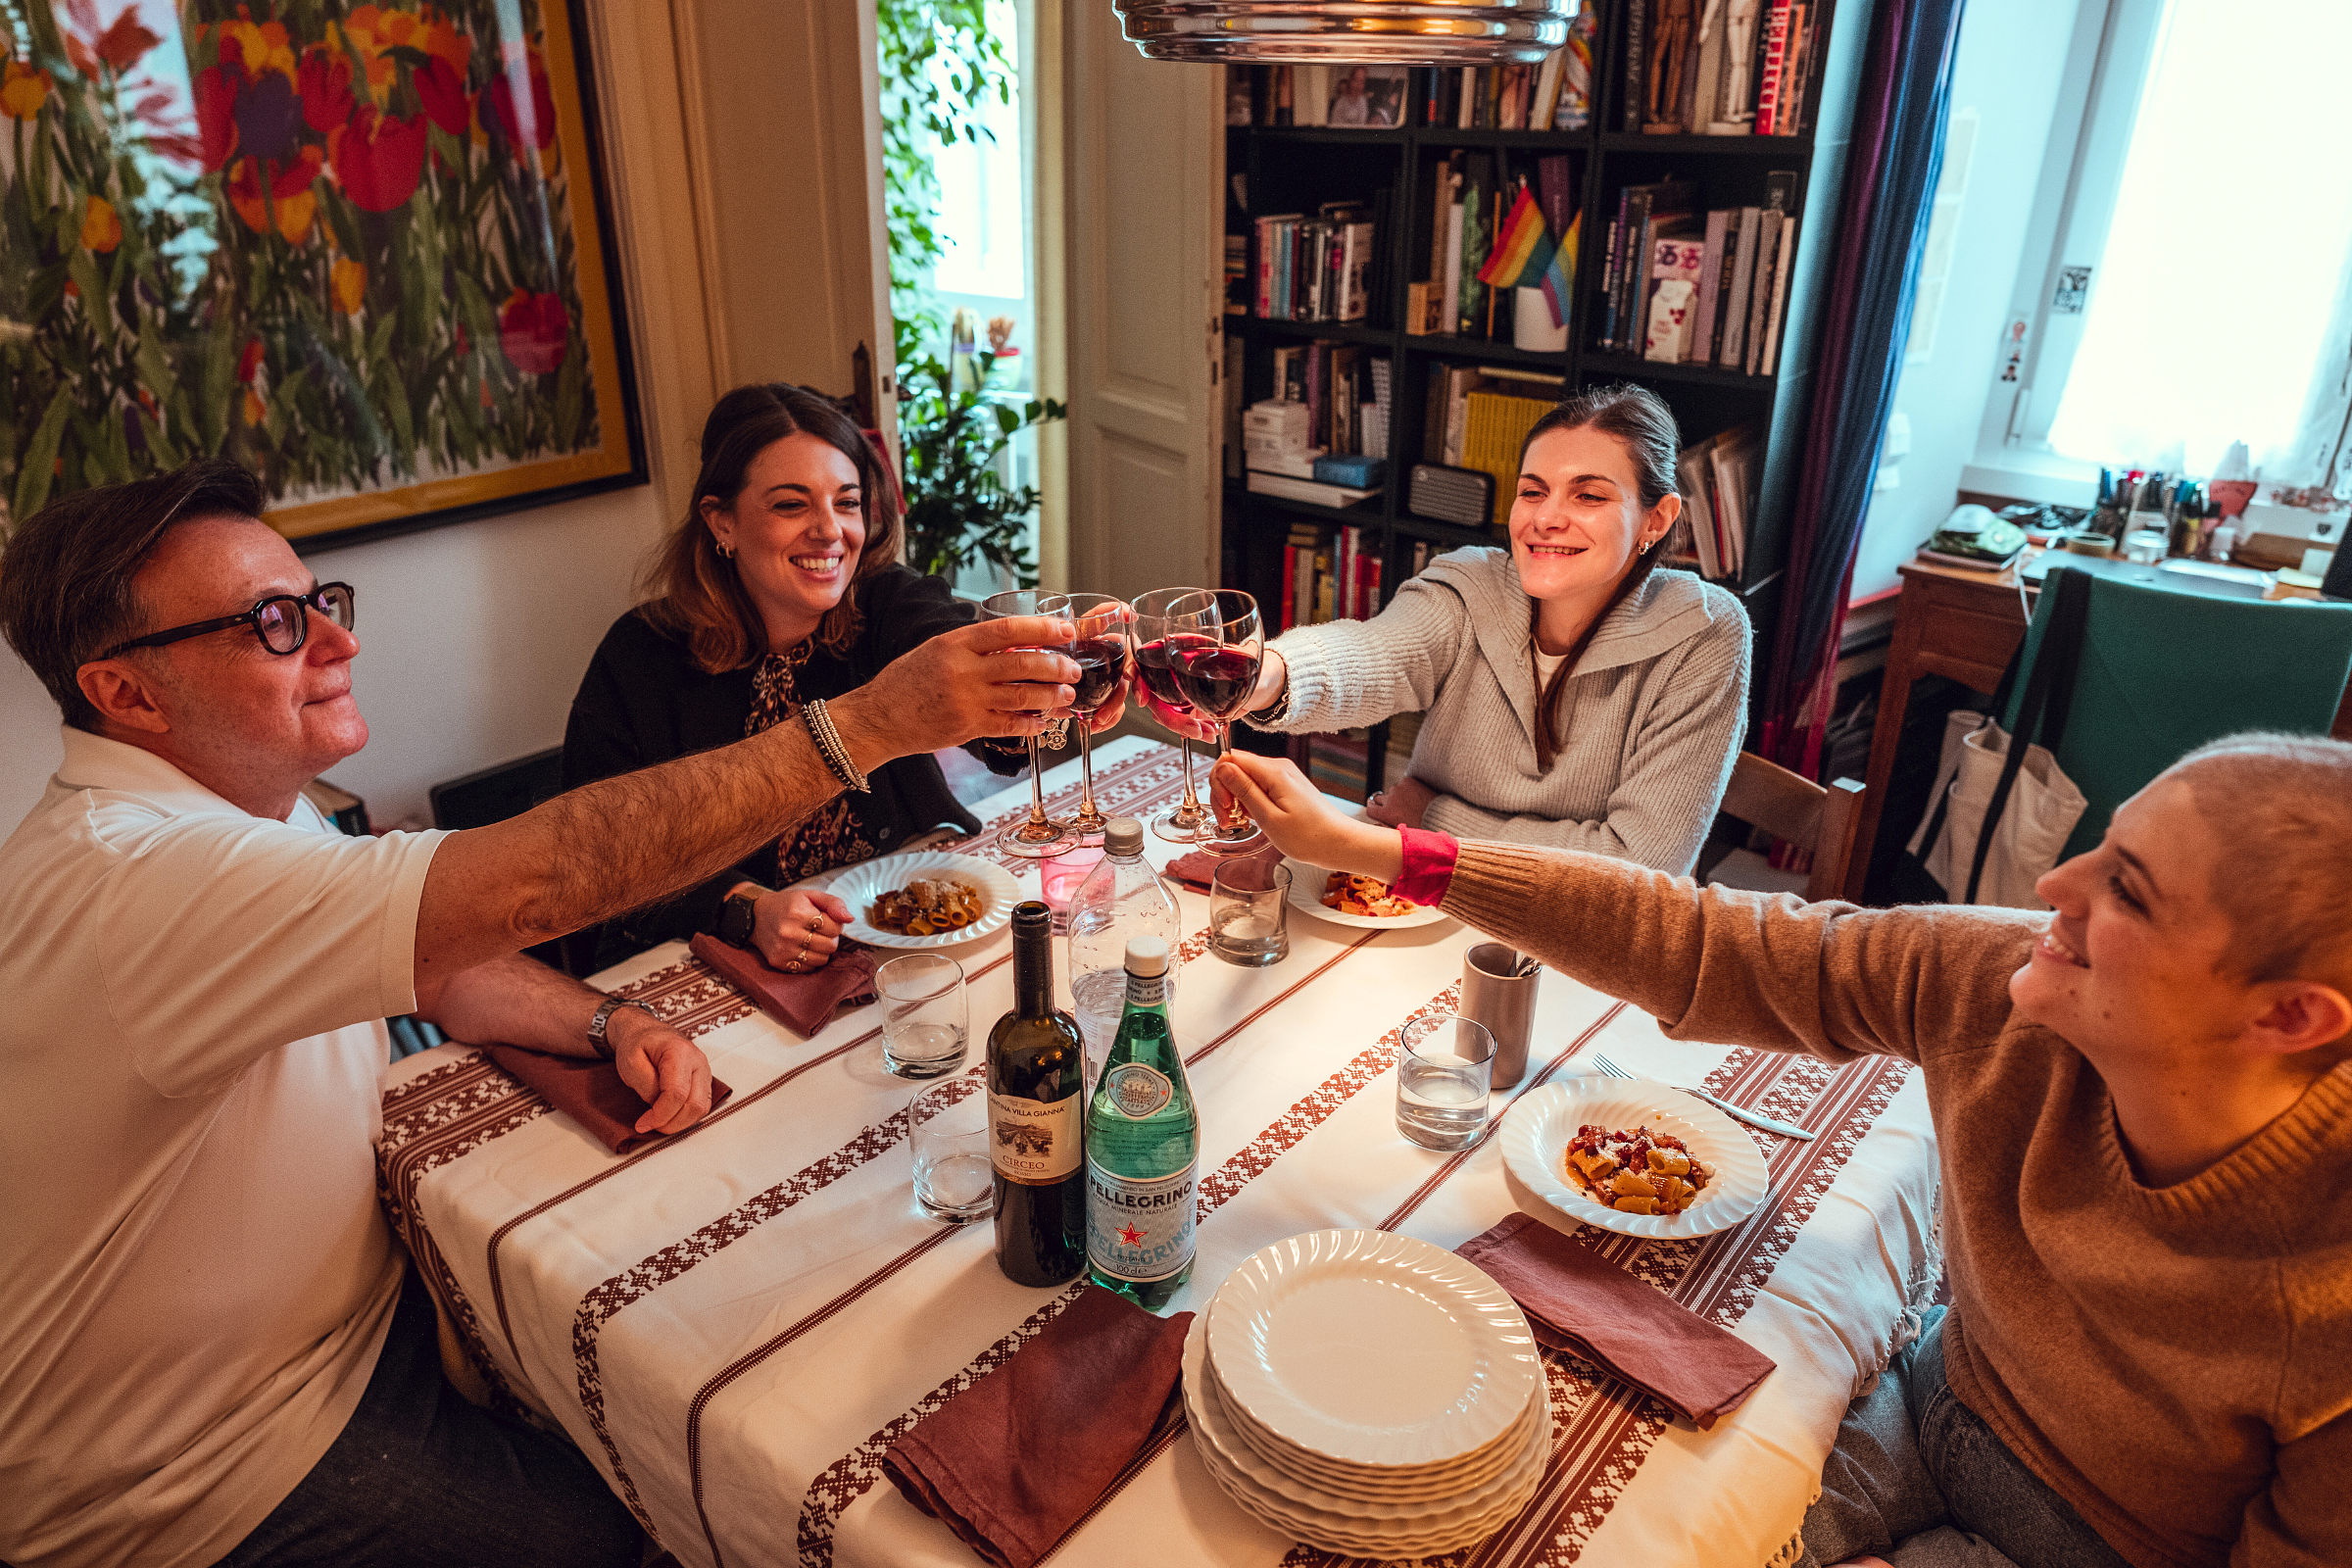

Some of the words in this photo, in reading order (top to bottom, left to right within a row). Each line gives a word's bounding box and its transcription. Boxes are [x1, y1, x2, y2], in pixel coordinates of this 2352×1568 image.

[988, 1094, 1011, 1113] CANTINA
[1012, 1108, 1032, 1117] VILLA
[1003, 1154, 1045, 1170] CIRCEO
[1093, 1192, 1109, 1207] ACQUA
[1111, 1204, 1144, 1216] MINERALE
[1146, 1203, 1178, 1216] NATURALE
[1115, 1263, 1130, 1274] 100
